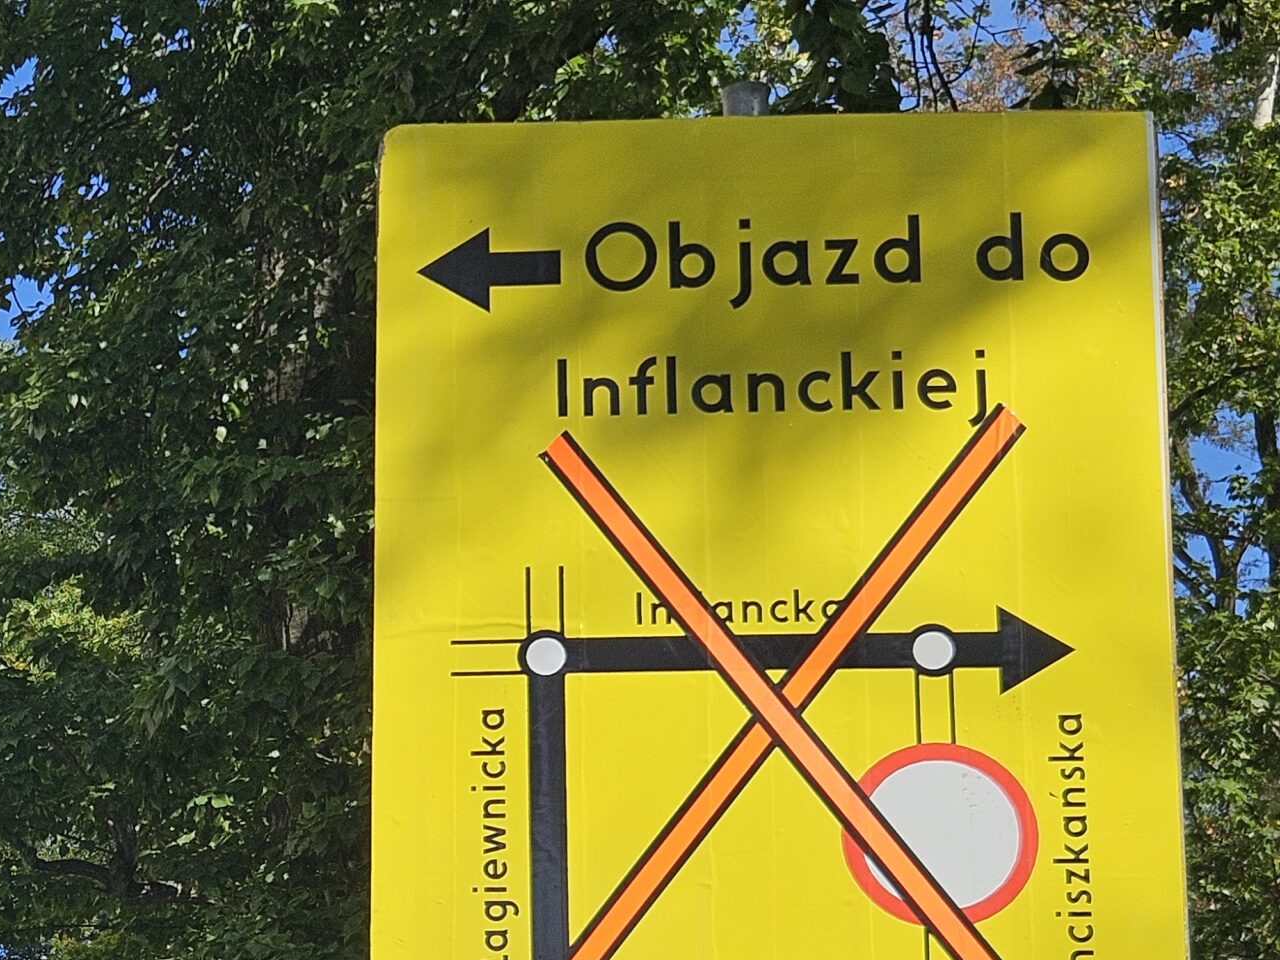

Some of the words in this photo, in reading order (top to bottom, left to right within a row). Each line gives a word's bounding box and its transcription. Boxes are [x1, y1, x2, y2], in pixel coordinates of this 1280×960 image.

[584, 213, 922, 308] Objazd
[974, 212, 1090, 282] do
[556, 350, 988, 428] Inflanckiej
